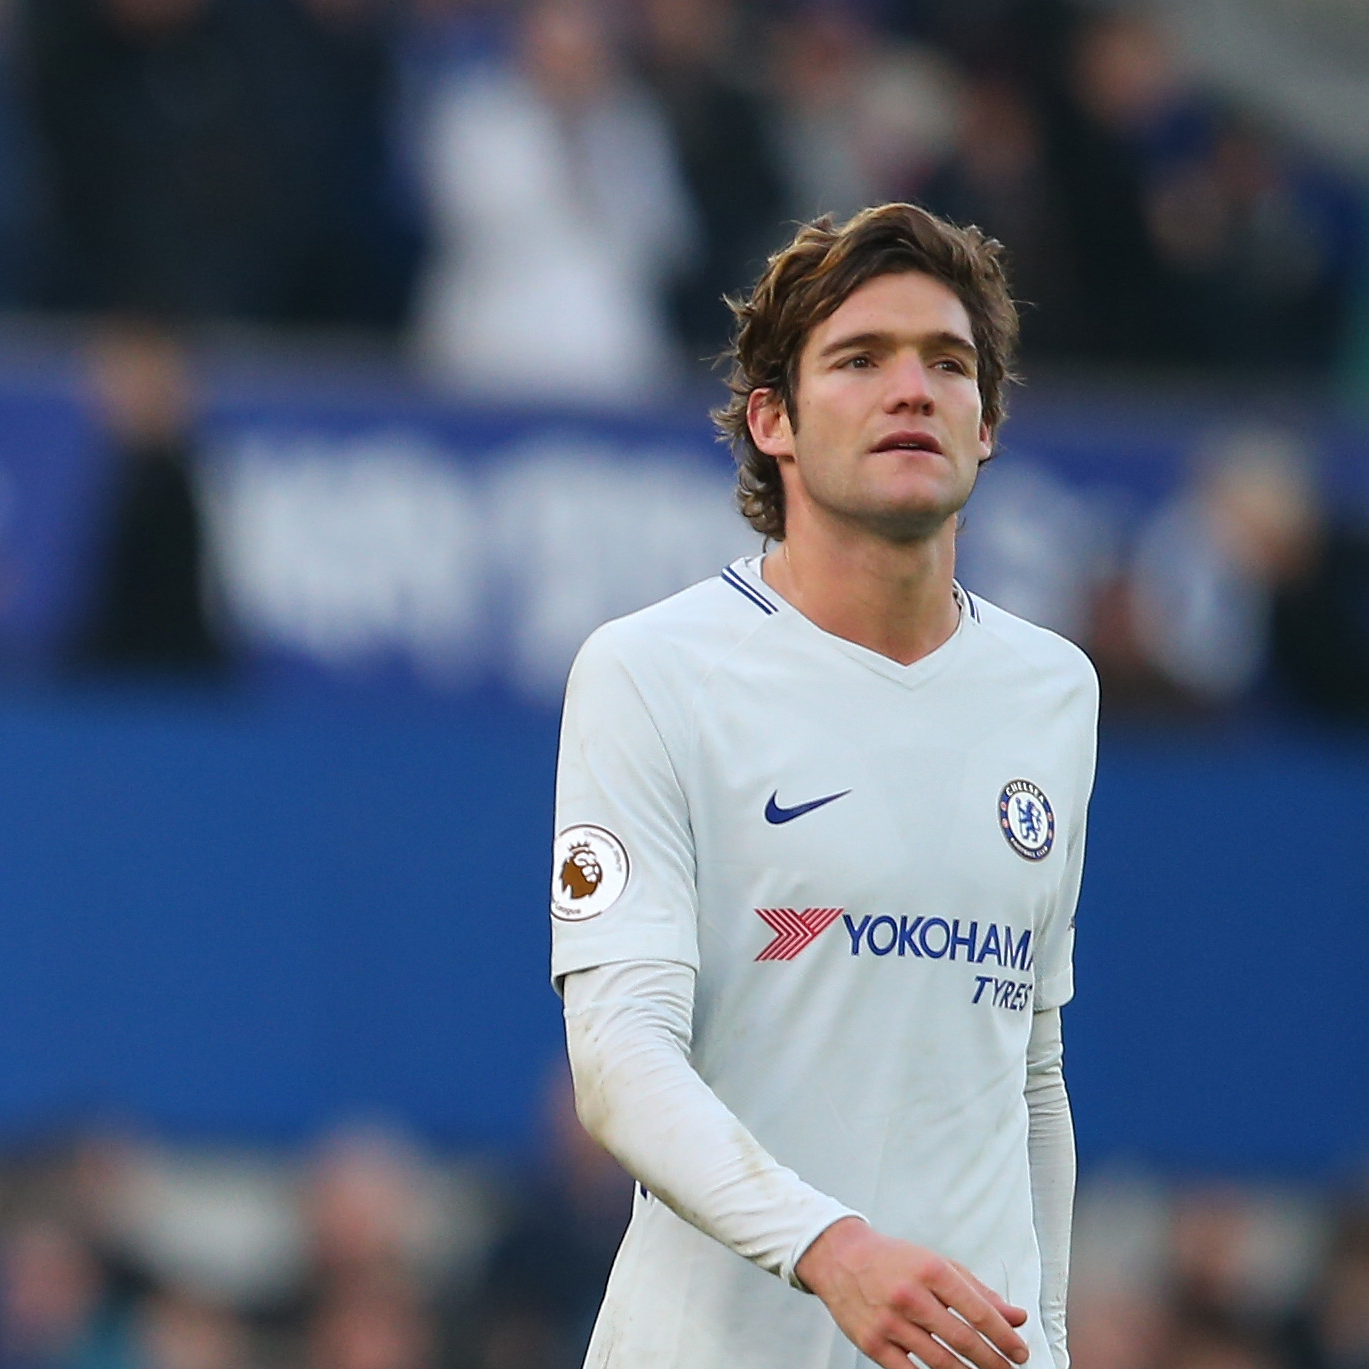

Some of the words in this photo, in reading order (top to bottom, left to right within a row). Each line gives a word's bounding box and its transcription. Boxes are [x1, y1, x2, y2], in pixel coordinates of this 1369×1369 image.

[1005, 781, 1045, 804] CHELSEA
[842, 914, 1034, 972] YOKOHAM
[970, 975, 1033, 1012] TYRES
